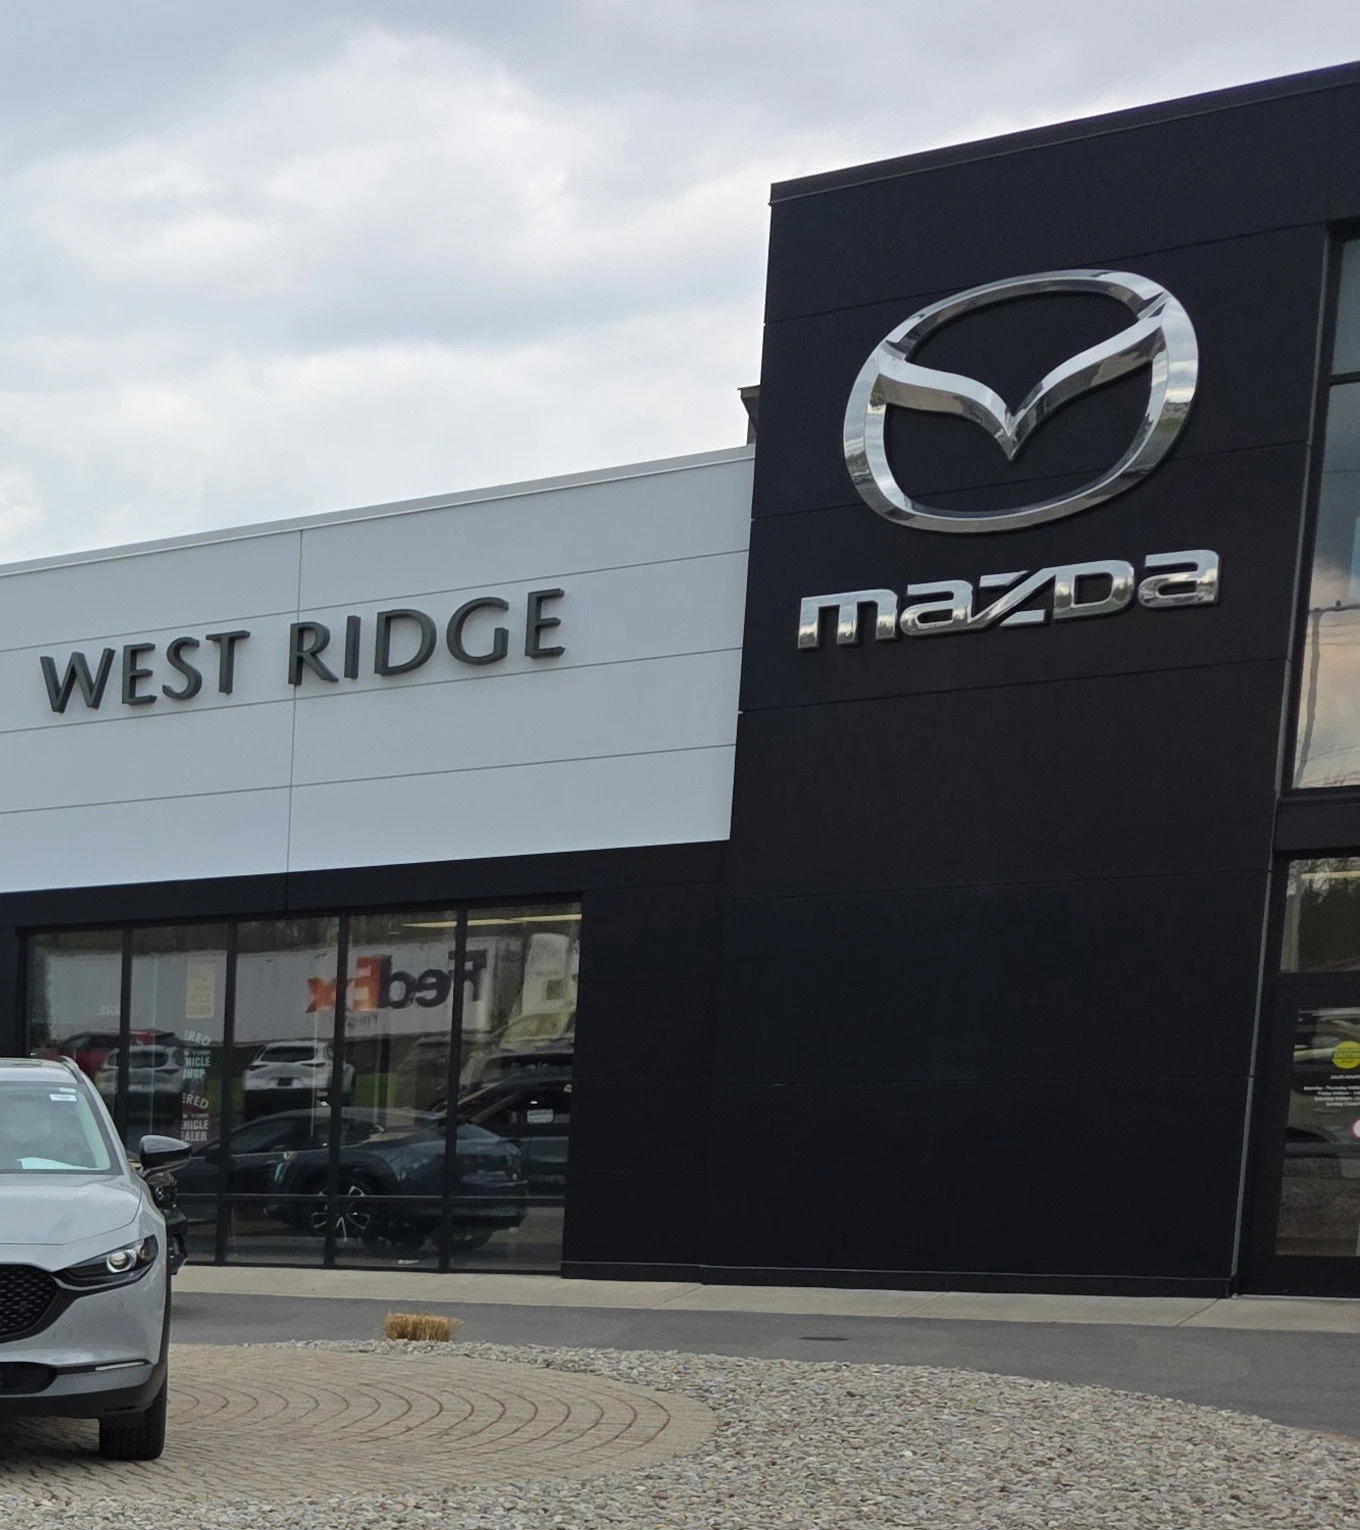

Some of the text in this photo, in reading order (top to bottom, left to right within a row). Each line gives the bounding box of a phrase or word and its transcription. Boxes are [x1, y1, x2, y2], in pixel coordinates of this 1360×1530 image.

[39, 588, 566, 714] WEST RIDGE
[798, 549, 1219, 649] mazda
